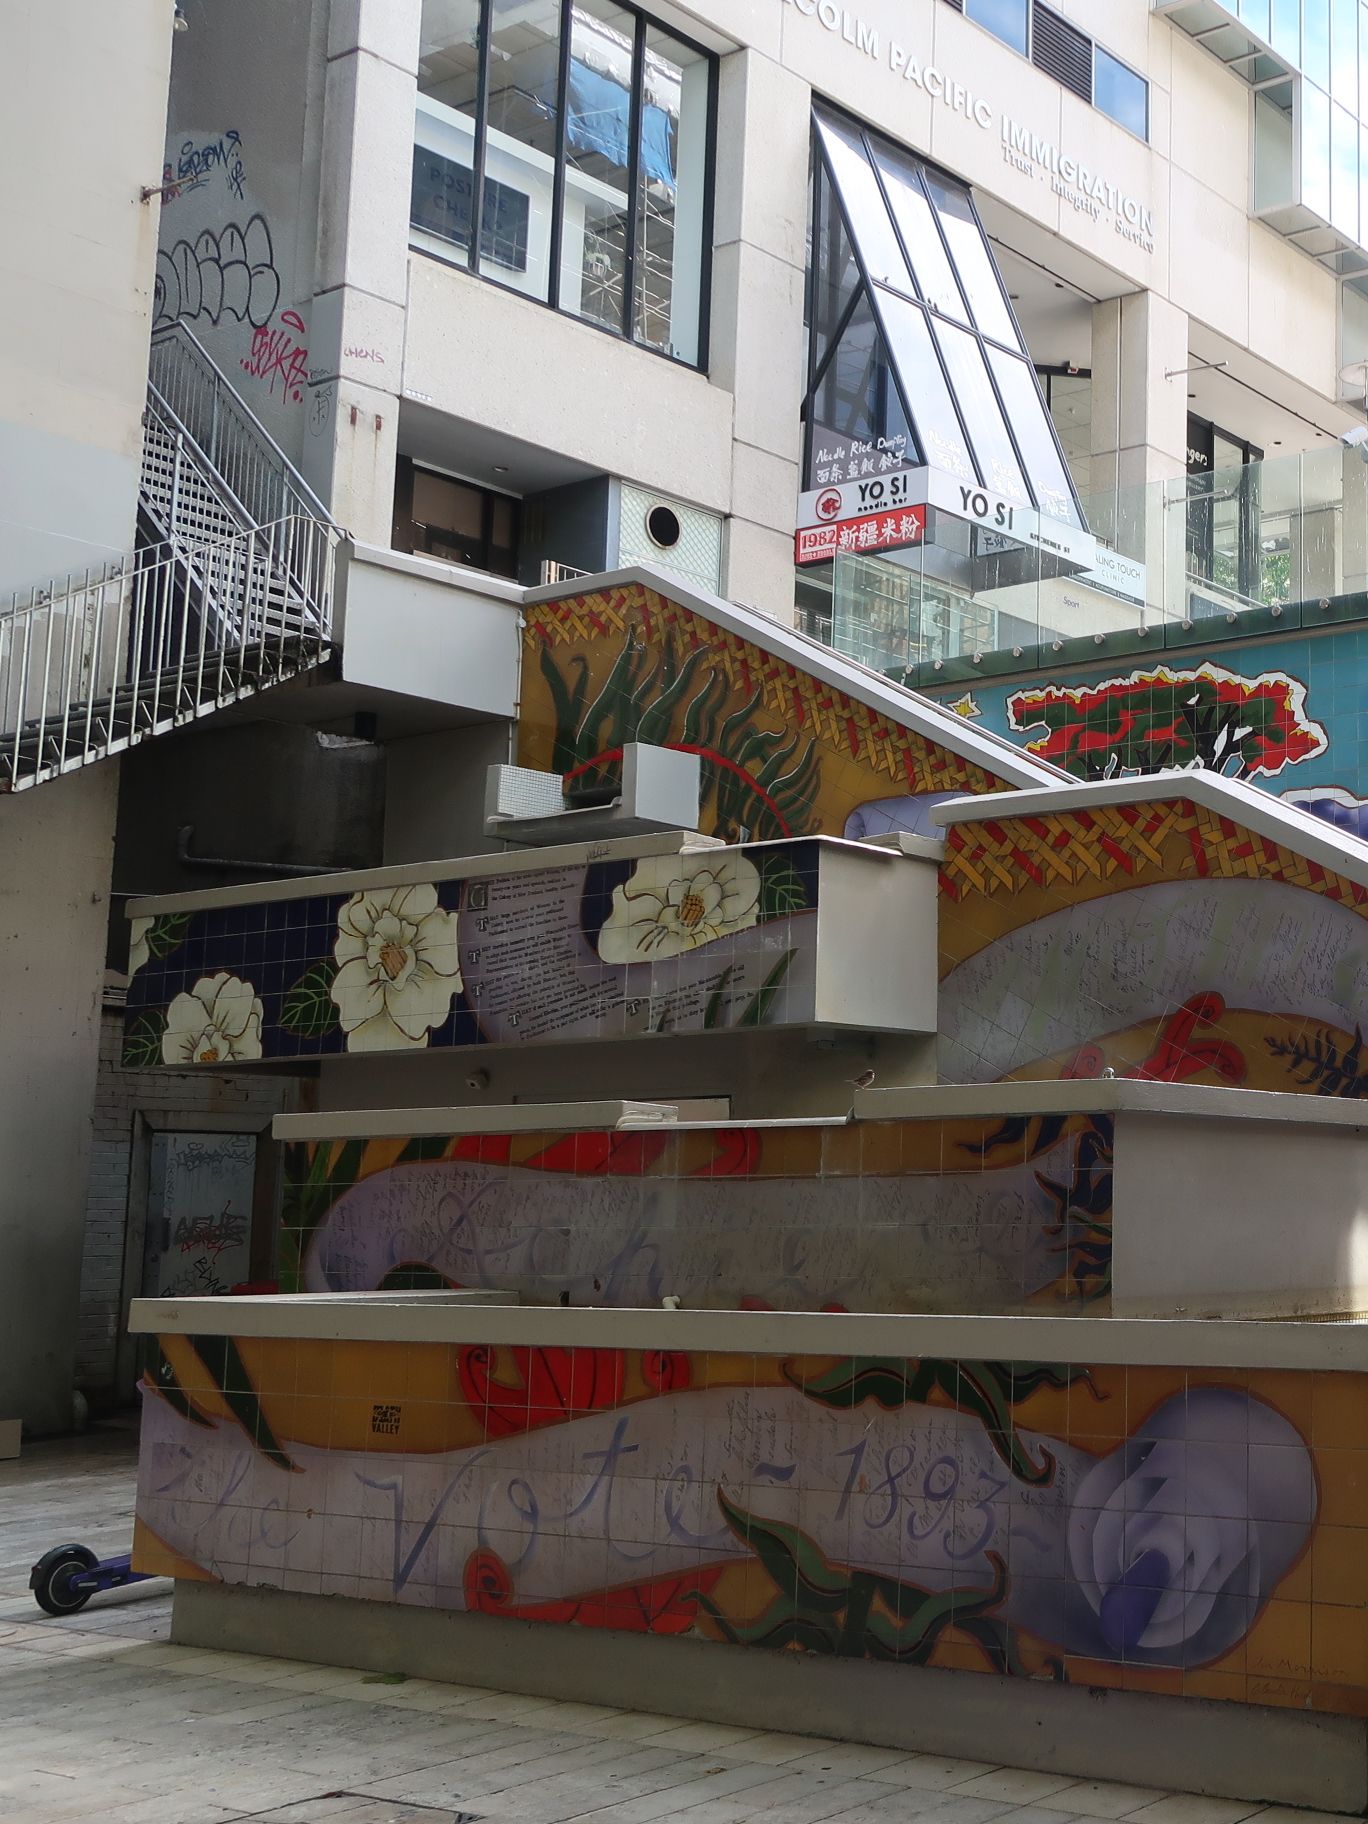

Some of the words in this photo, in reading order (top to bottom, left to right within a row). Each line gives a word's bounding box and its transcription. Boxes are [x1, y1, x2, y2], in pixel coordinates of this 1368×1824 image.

[786, 0, 879, 59] COLM
[889, 41, 993, 129] PACIFIC
[1001, 114, 1153, 237] IMMIGRATION
[430, 166, 508, 214] POSTRE
[1001, 144, 1035, 178] Trust
[1051, 176, 1100, 223] Integrity
[1115, 219, 1154, 254] Service
[850, 441, 873, 457] Rice
[858, 480, 884, 502] YO
[890, 474, 907, 495] SI
[858, 501, 888, 512] noodle
[892, 497, 908, 505] bar
[960, 485, 988, 517] YO
[994, 502, 1013, 530] SI
[800, 530, 836, 550] 1982
[838, 513, 921, 549] 新疆米粉
[1101, 568, 1125, 585] CLINIC
[1117, 562, 1140, 580] TOUCH
[1063, 596, 1080, 609] Sport
[372, 1422, 400, 1435] VALLEY
[354, 1416, 730, 1595] Vote
[834, 1437, 1009, 1560] 1893
